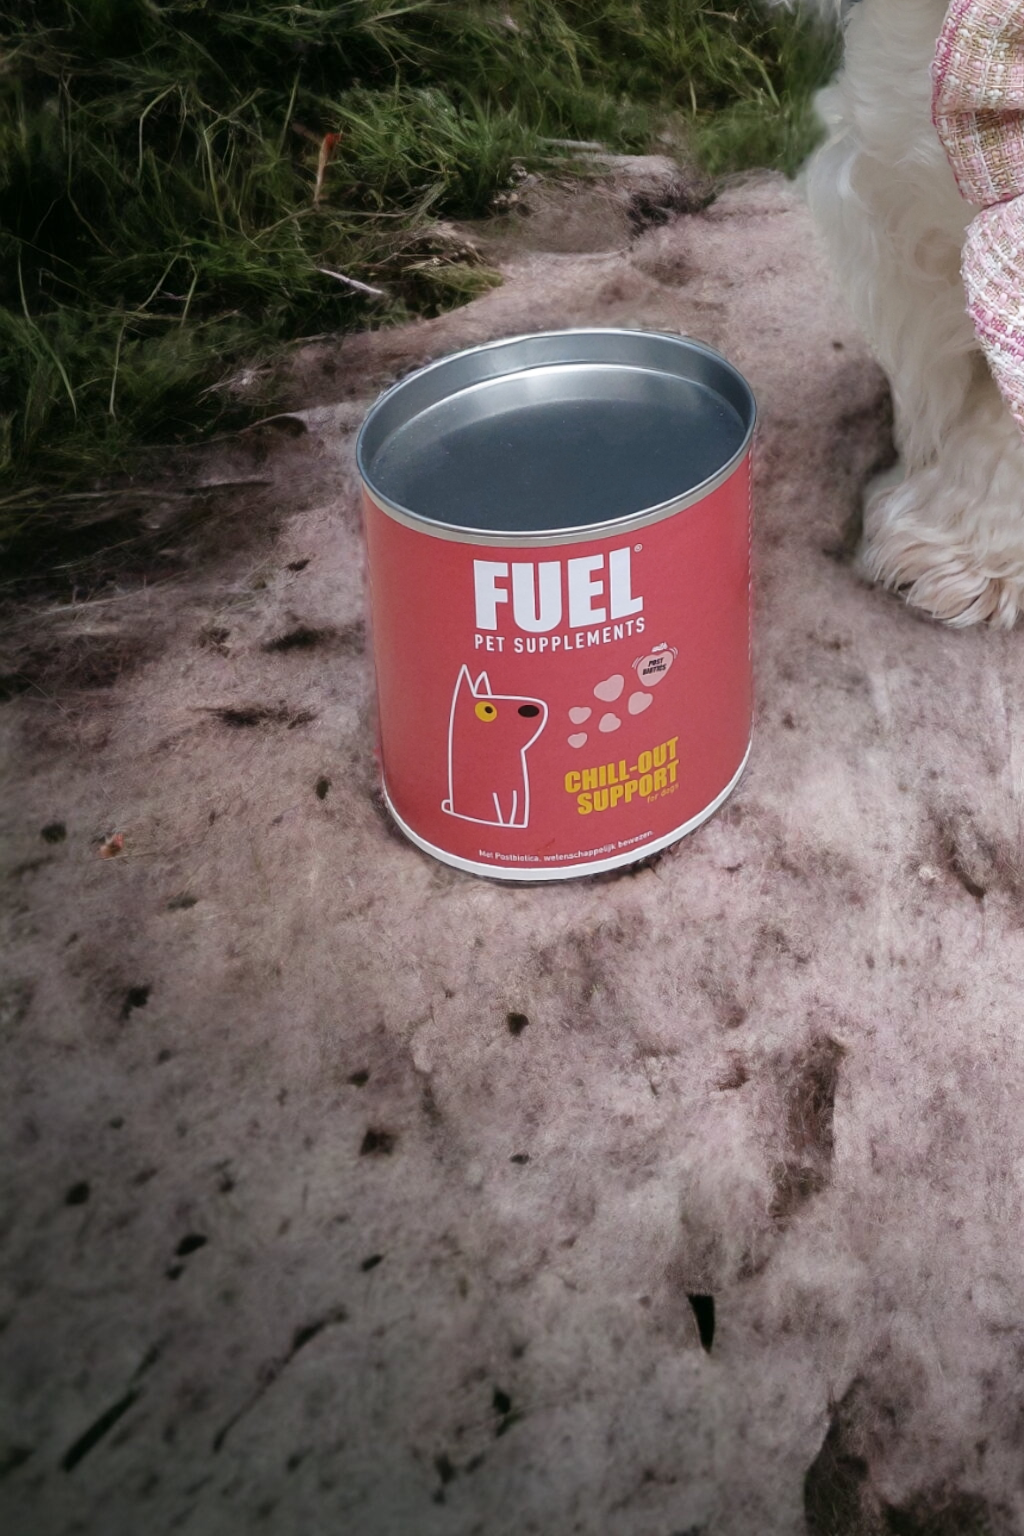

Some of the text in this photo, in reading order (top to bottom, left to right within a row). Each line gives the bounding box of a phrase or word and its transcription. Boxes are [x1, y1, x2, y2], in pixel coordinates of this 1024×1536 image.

[473, 546, 644, 633] FUEL
[474, 633, 506, 652] PET
[513, 617, 646, 653] SUPPLEMENTS
[564, 736, 679, 793] CHILL-OUT
[577, 759, 680, 815] SUPPORT
[543, 842, 616, 862] wetenschappelijk
